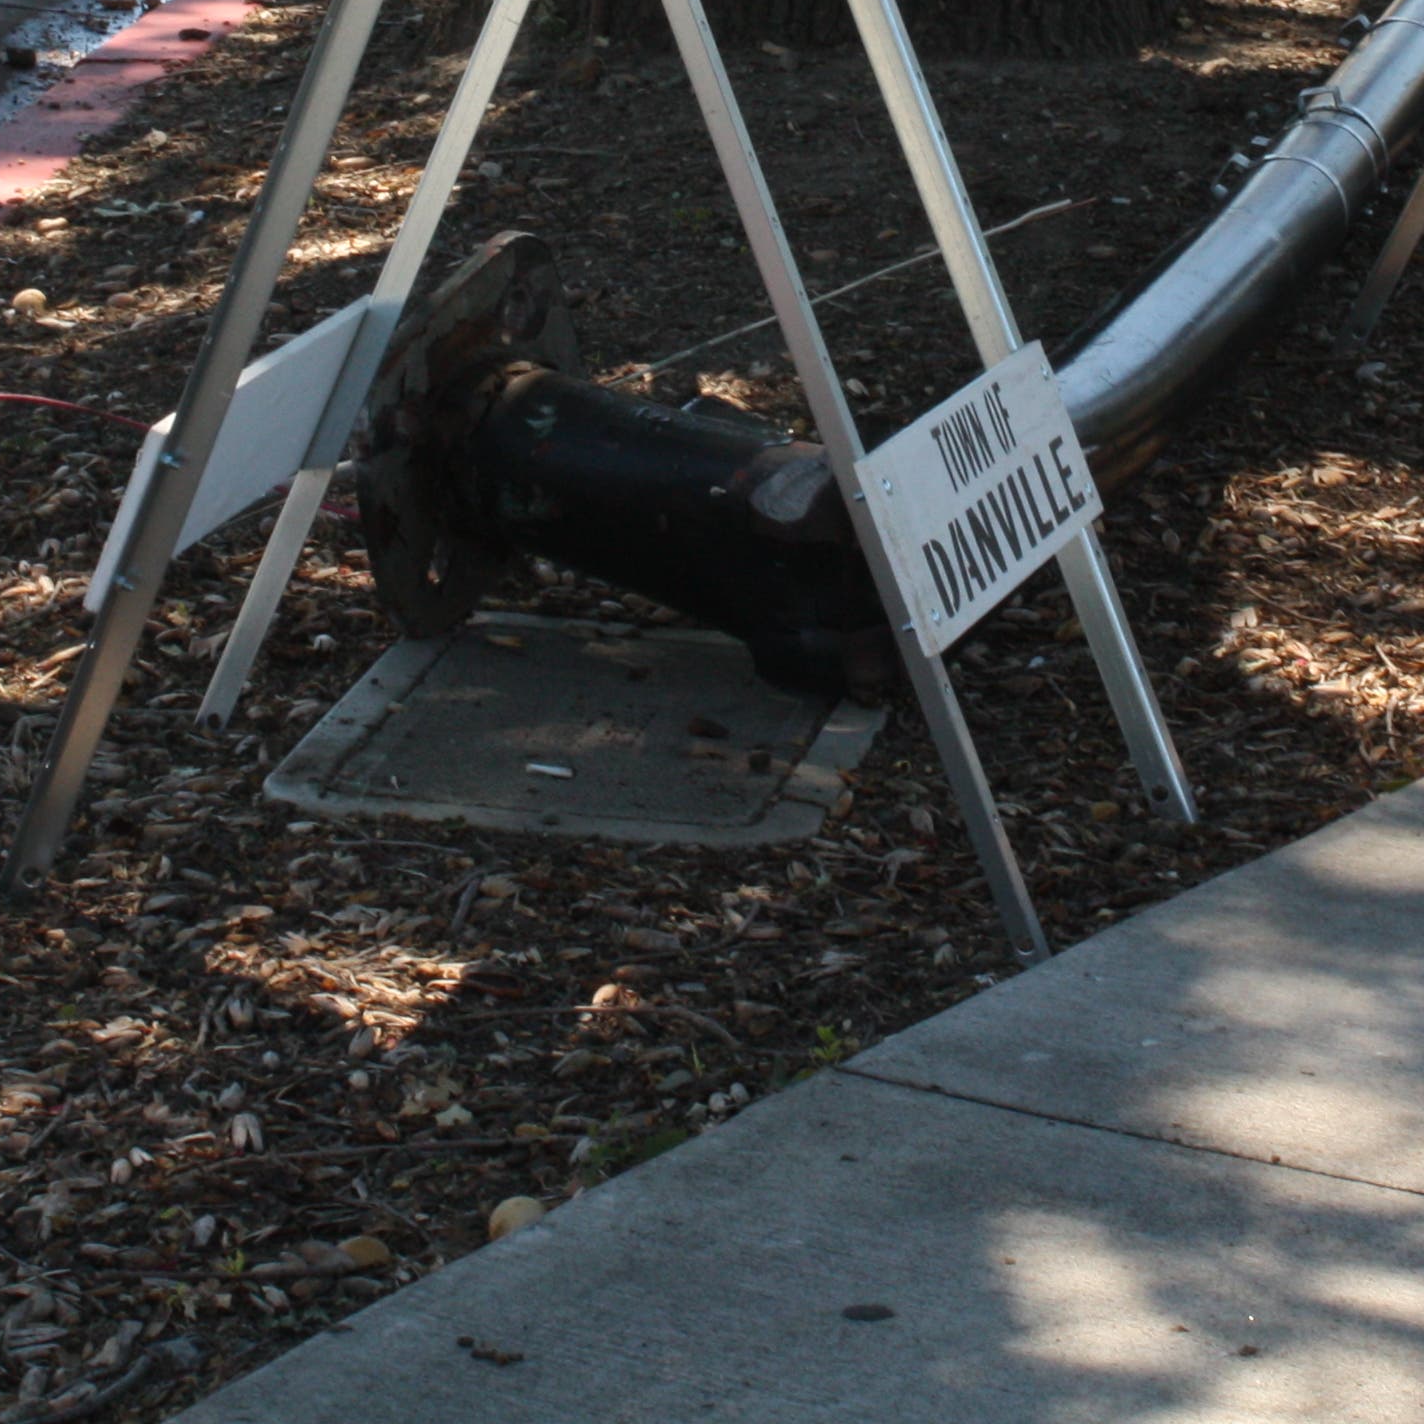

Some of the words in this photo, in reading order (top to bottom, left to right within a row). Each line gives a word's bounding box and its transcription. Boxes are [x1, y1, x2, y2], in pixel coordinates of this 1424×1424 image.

[929, 399, 997, 494] TOWN
[982, 381, 1018, 456] OF
[921, 434, 1087, 619] DANVILLE
